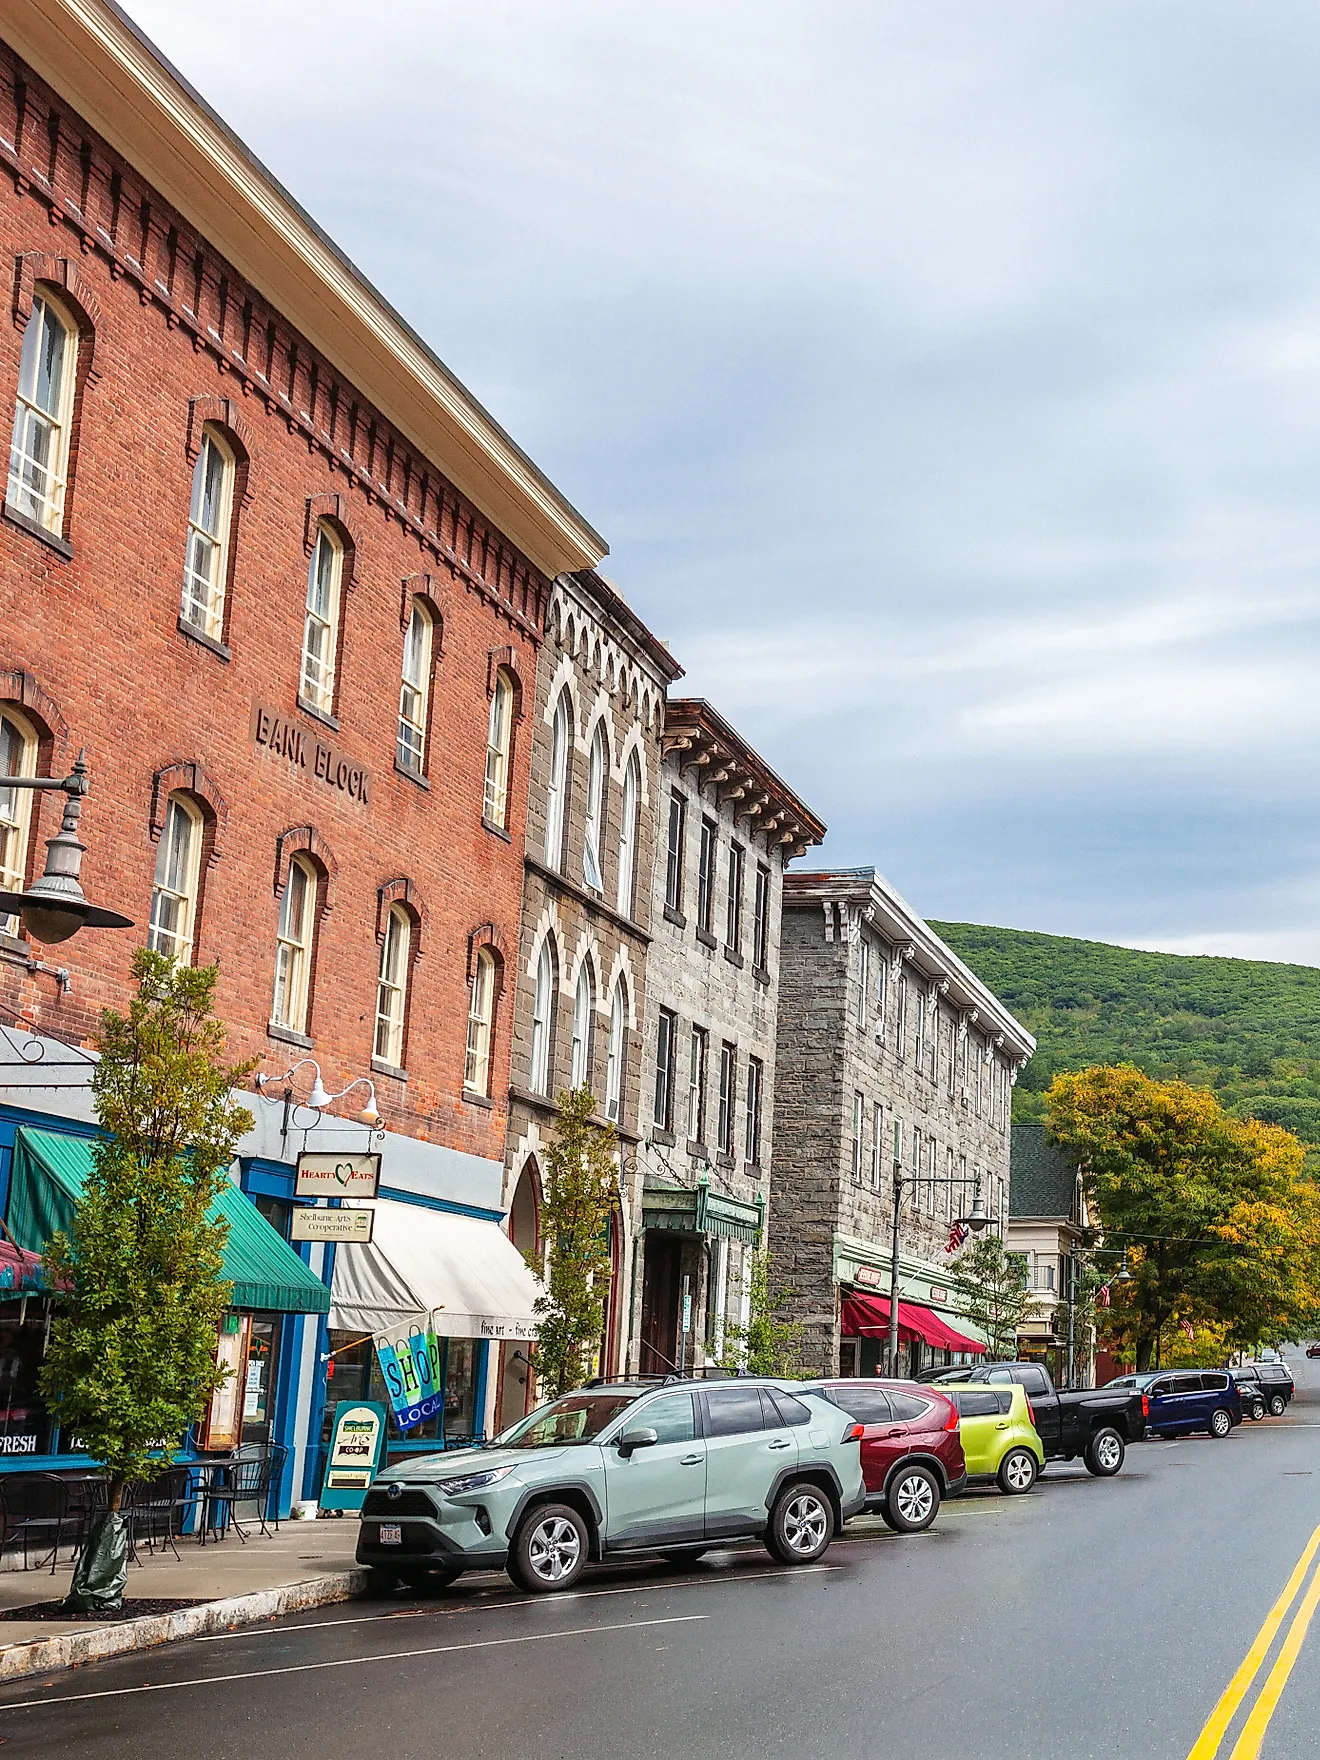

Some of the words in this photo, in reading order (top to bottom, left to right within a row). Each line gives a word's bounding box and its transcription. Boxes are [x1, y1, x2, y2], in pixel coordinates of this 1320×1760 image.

[255, 708, 308, 768] BANK
[314, 743, 369, 805] BLOCK
[300, 1213, 334, 1222] Shelburne
[387, 1344, 438, 1398] SHOP
[397, 1396, 441, 1426] LOCAL
